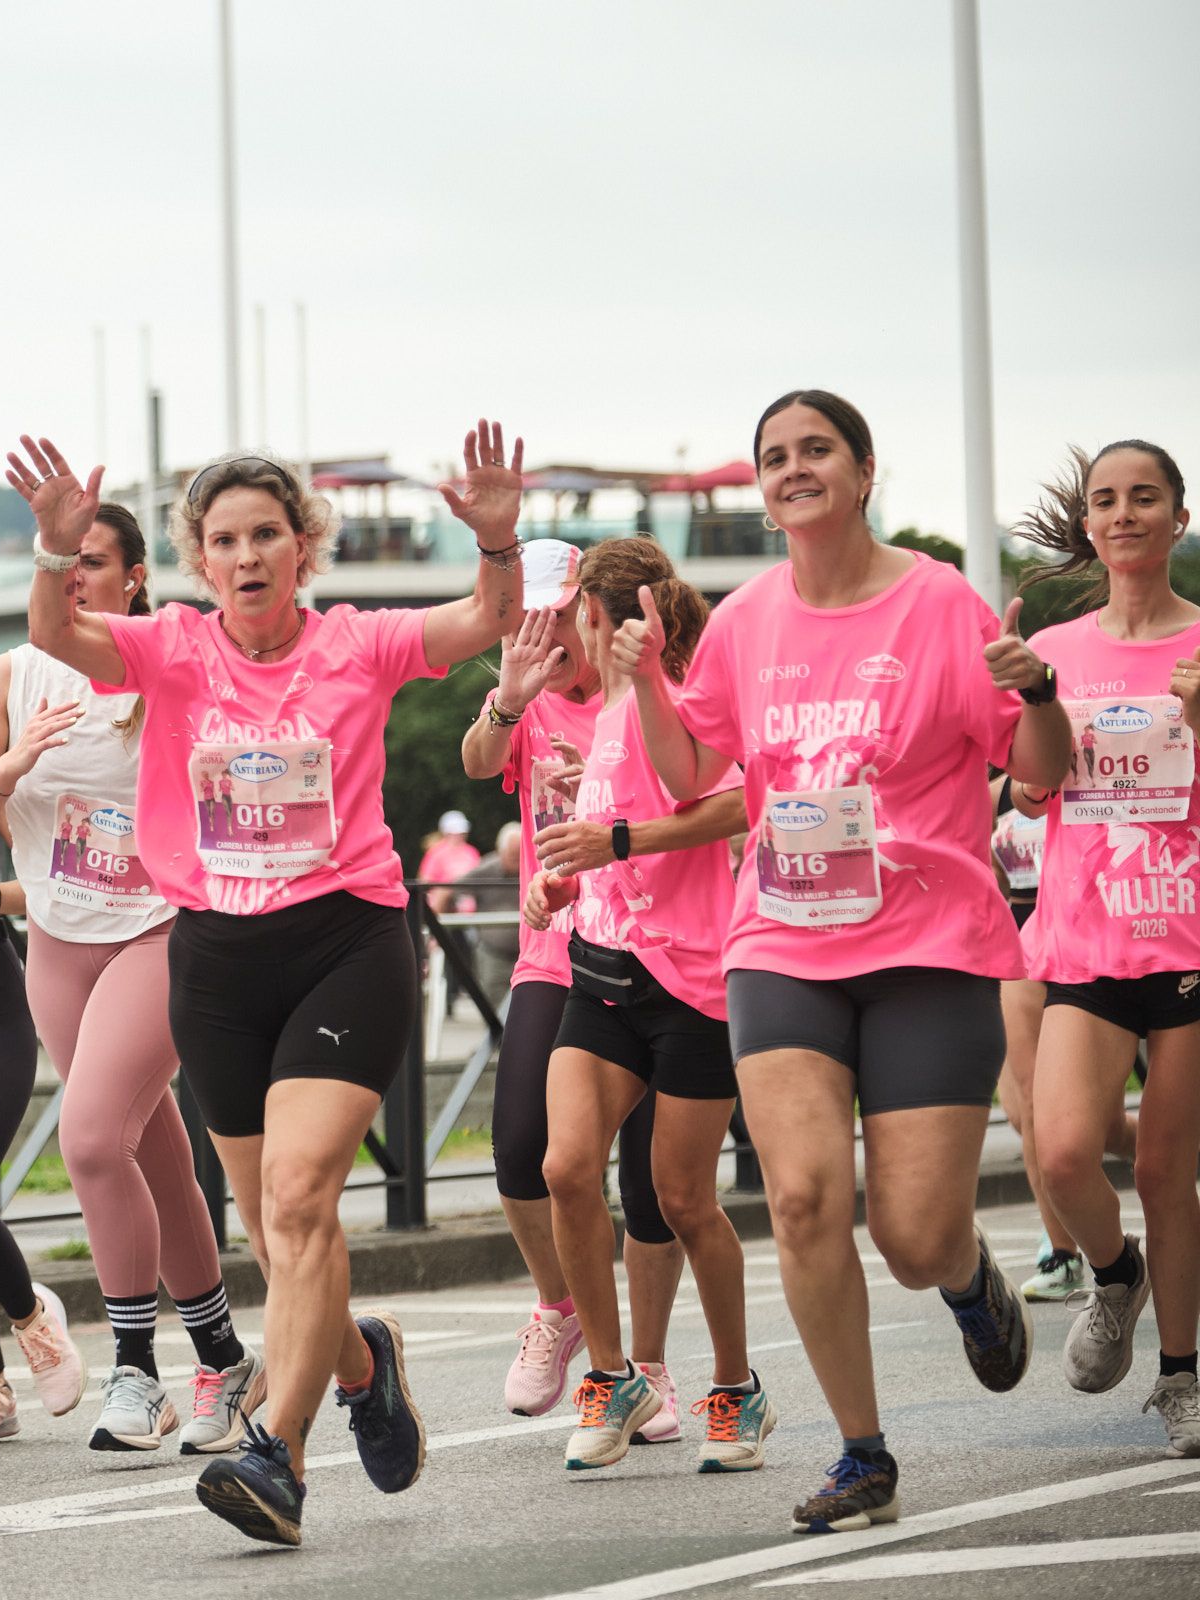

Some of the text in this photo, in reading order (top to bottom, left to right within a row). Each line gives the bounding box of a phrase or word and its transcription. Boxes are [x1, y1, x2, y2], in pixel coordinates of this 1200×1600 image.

[758, 663, 811, 683] OYSHO
[1073, 680, 1126, 697] OYSHO
[199, 708, 318, 744] CARRERA
[763, 699, 881, 745] CARRERA
[1097, 717, 1149, 728] ASTURIANA
[234, 763, 283, 775] ASTURIANA
[1098, 754, 1150, 776] 016
[1112, 779, 1137, 789] 4922
[1079, 788, 1176, 800] CARRERA DE LA MUJER GIJÓN
[288, 802, 328, 811] CORREDORA
[1075, 806, 1114, 817] OYSHO
[1140, 805, 1182, 815] Santander
[236, 804, 286, 828] 016
[773, 810, 823, 824] ASTURIANA
[252, 832, 269, 842] 429
[216, 841, 243, 851] CARRERA
[244, 842, 253, 851] DE
[261, 842, 286, 851] MUJER
[291, 840, 313, 850] GIJÓN
[1142, 831, 1175, 875] LA
[86, 849, 130, 874] 016
[208, 856, 250, 869] OYSHO
[275, 859, 320, 869] Santander
[776, 853, 829, 876] 016
[64, 874, 88, 887] CARRERA
[88, 881, 98, 889] DE
[105, 885, 126, 894] MUJER
[97, 873, 113, 885] 842
[789, 880, 815, 890] 1373
[57, 886, 93, 903] OYSHO
[794, 892, 803, 900] LA
[804, 891, 830, 900] MUJER
[835, 888, 858, 897] GIJÓN
[1097, 876, 1196, 918] MUJER
[114, 900, 152, 909] Santander
[765, 901, 793, 917] OYSHO
[819, 906, 865, 917] Santander
[1131, 918, 1168, 940] 2026
[1181, 973, 1200, 987] NIKE
